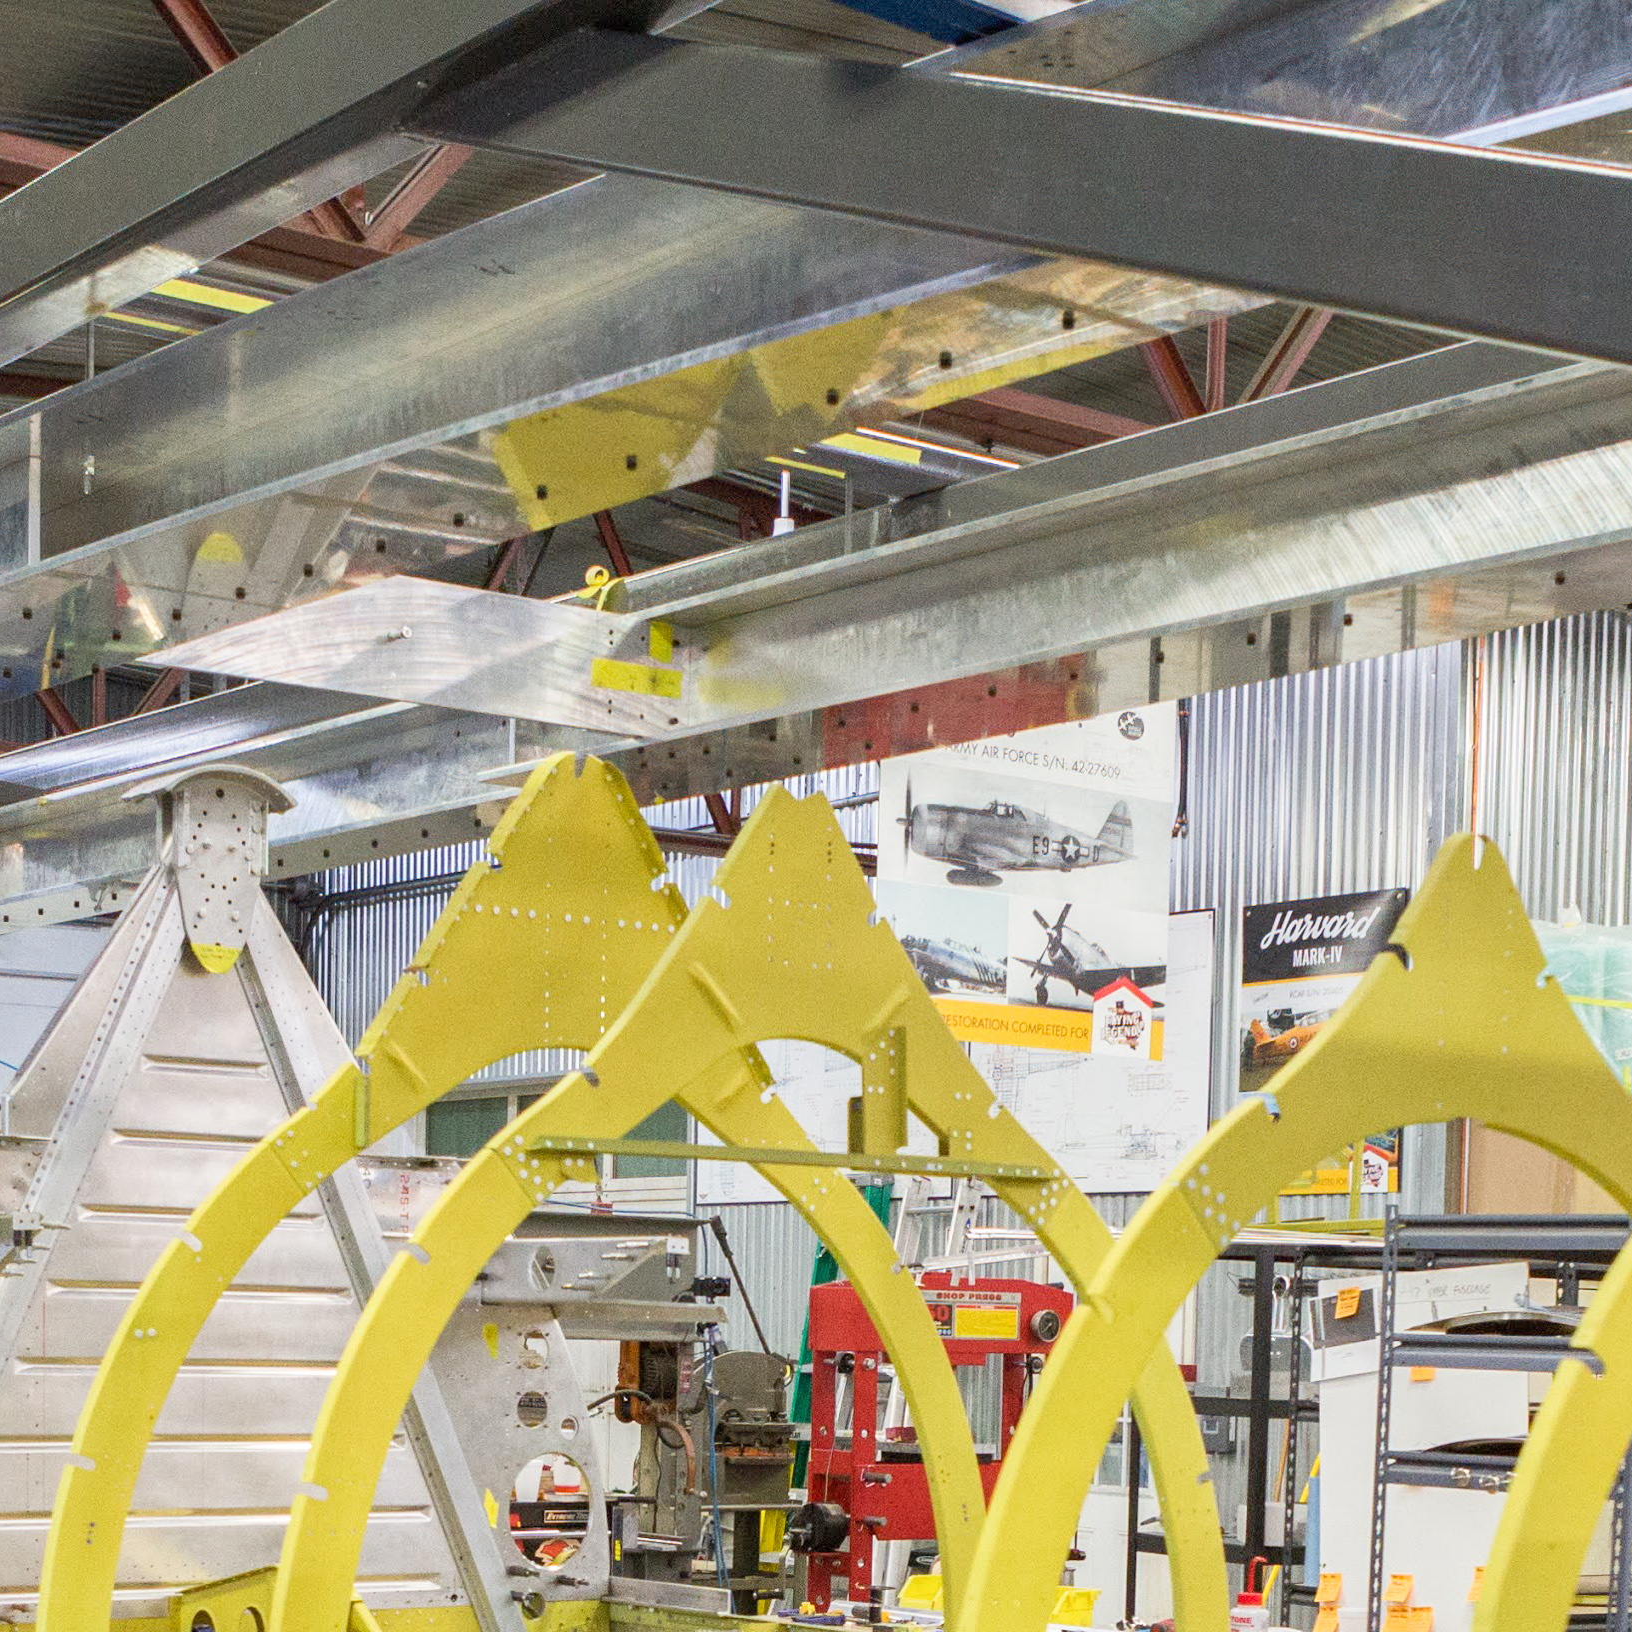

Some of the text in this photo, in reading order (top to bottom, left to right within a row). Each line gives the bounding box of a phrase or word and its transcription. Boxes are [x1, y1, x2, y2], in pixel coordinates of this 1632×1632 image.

[981, 745, 999, 760] AIR
[1002, 748, 1039, 766] FORCE
[1042, 753, 1068, 771] S/N:
[1260, 906, 1381, 950] Harvard
[1293, 945, 1343, 967] MARK-IV
[1012, 1019, 1068, 1038] COMPLETED
[1070, 1025, 1089, 1040] FOR
[968, 1293, 1002, 1301] PRESS
